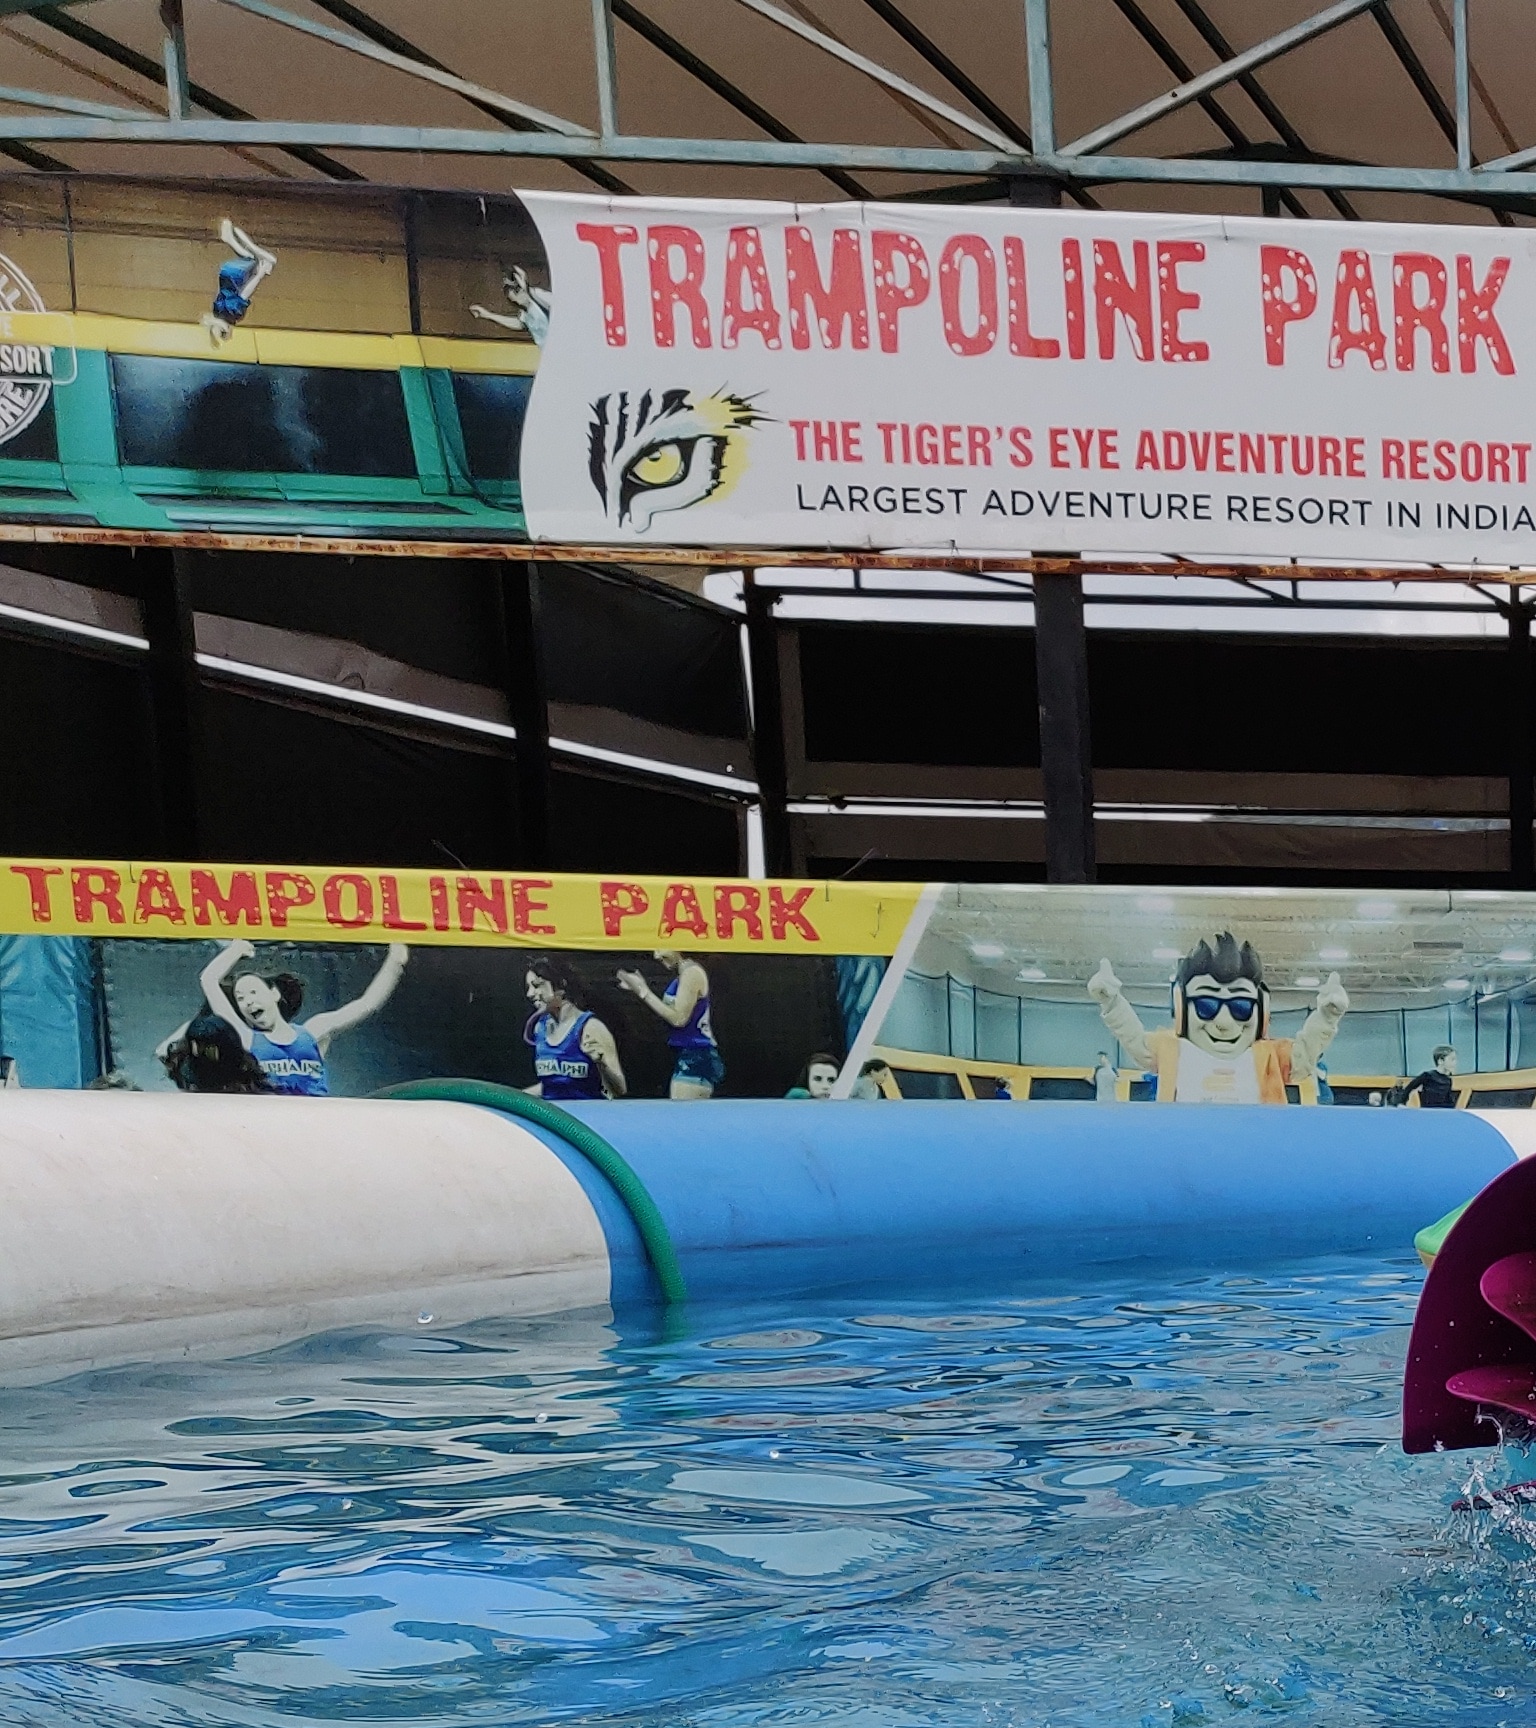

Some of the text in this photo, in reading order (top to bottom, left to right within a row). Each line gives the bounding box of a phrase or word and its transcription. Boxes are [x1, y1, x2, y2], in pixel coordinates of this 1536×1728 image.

[576, 222, 1516, 375] TRAMPOLINE PARK
[0, 345, 55, 376] SORT
[789, 420, 1533, 484] THE TIGER'S EYE ADVENTURE RESORT
[796, 484, 1536, 532] LARGEST ADVENTURE RESORT IN INDIA
[9, 865, 821, 942] TRAMPOLINE PARK
